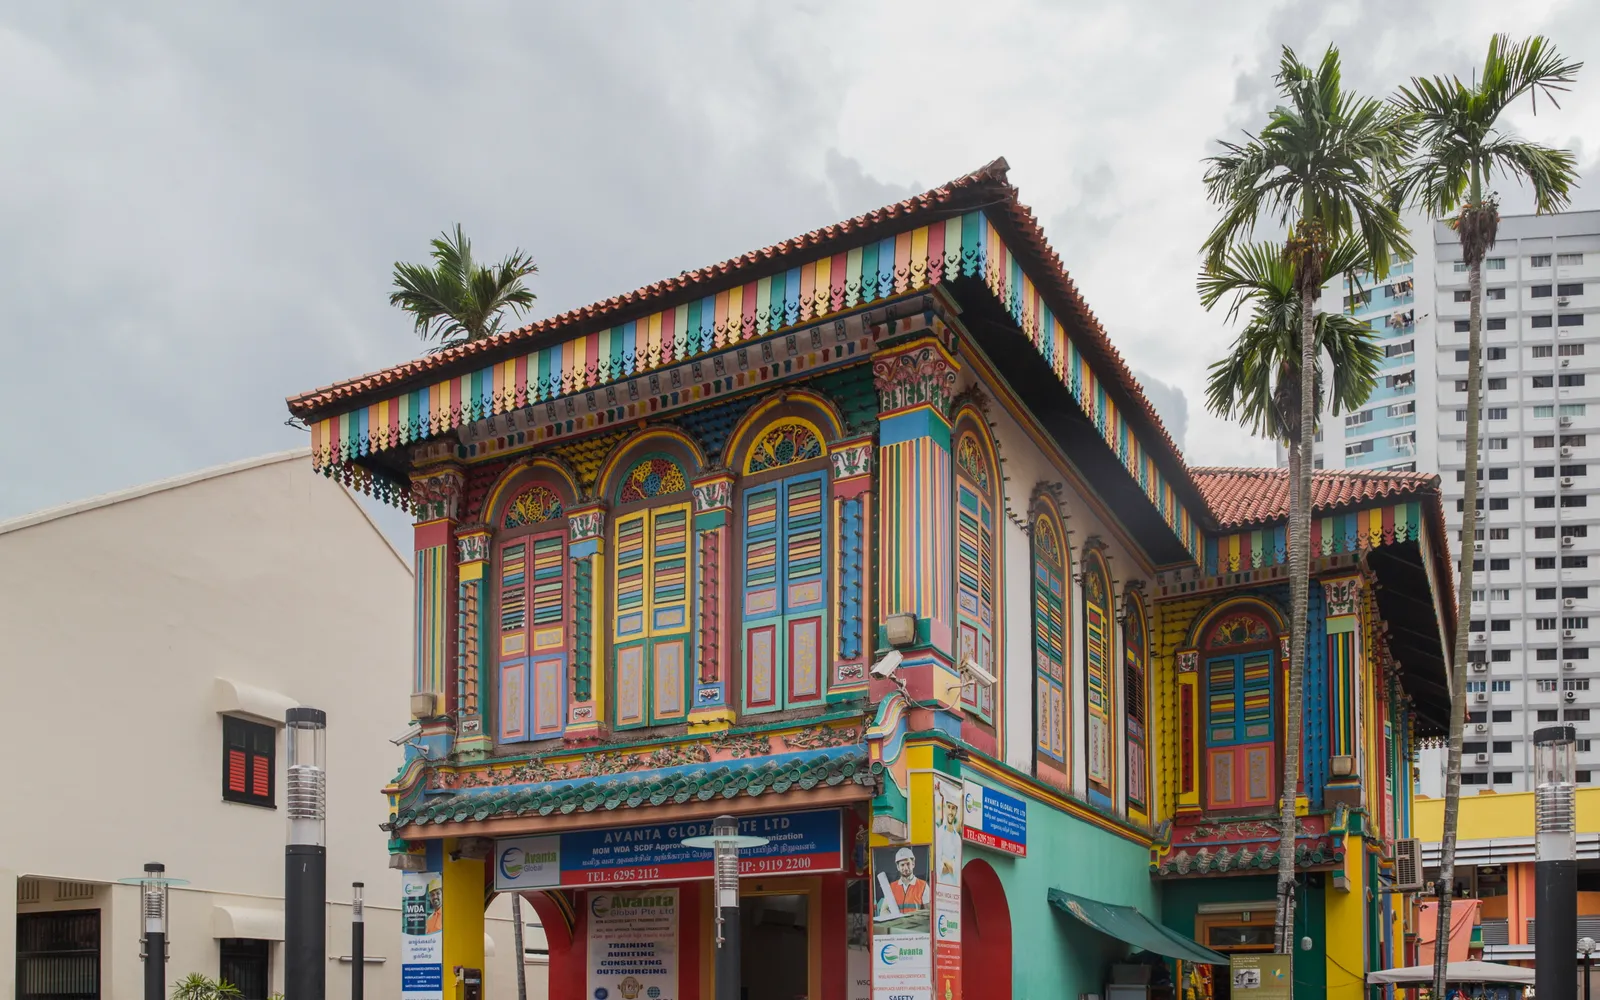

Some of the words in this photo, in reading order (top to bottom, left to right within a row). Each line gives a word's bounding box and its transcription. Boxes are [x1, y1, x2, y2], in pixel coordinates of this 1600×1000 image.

[604, 828, 661, 843] AVANTA
[668, 823, 715, 838] GLOBA
[738, 820, 756, 832] TE
[765, 817, 790, 830] LTD
[655, 843, 690, 851] Approve
[525, 851, 557, 864] Avanta
[524, 864, 543, 872] Global
[587, 871, 610, 882] TEL:
[613, 869, 635, 880] 6295
[638, 868, 659, 879] 2112
[759, 859, 783, 871] 9119
[786, 857, 811, 869] 2200
[611, 895, 674, 908] Avanta
[407, 904, 424, 913] WDA
